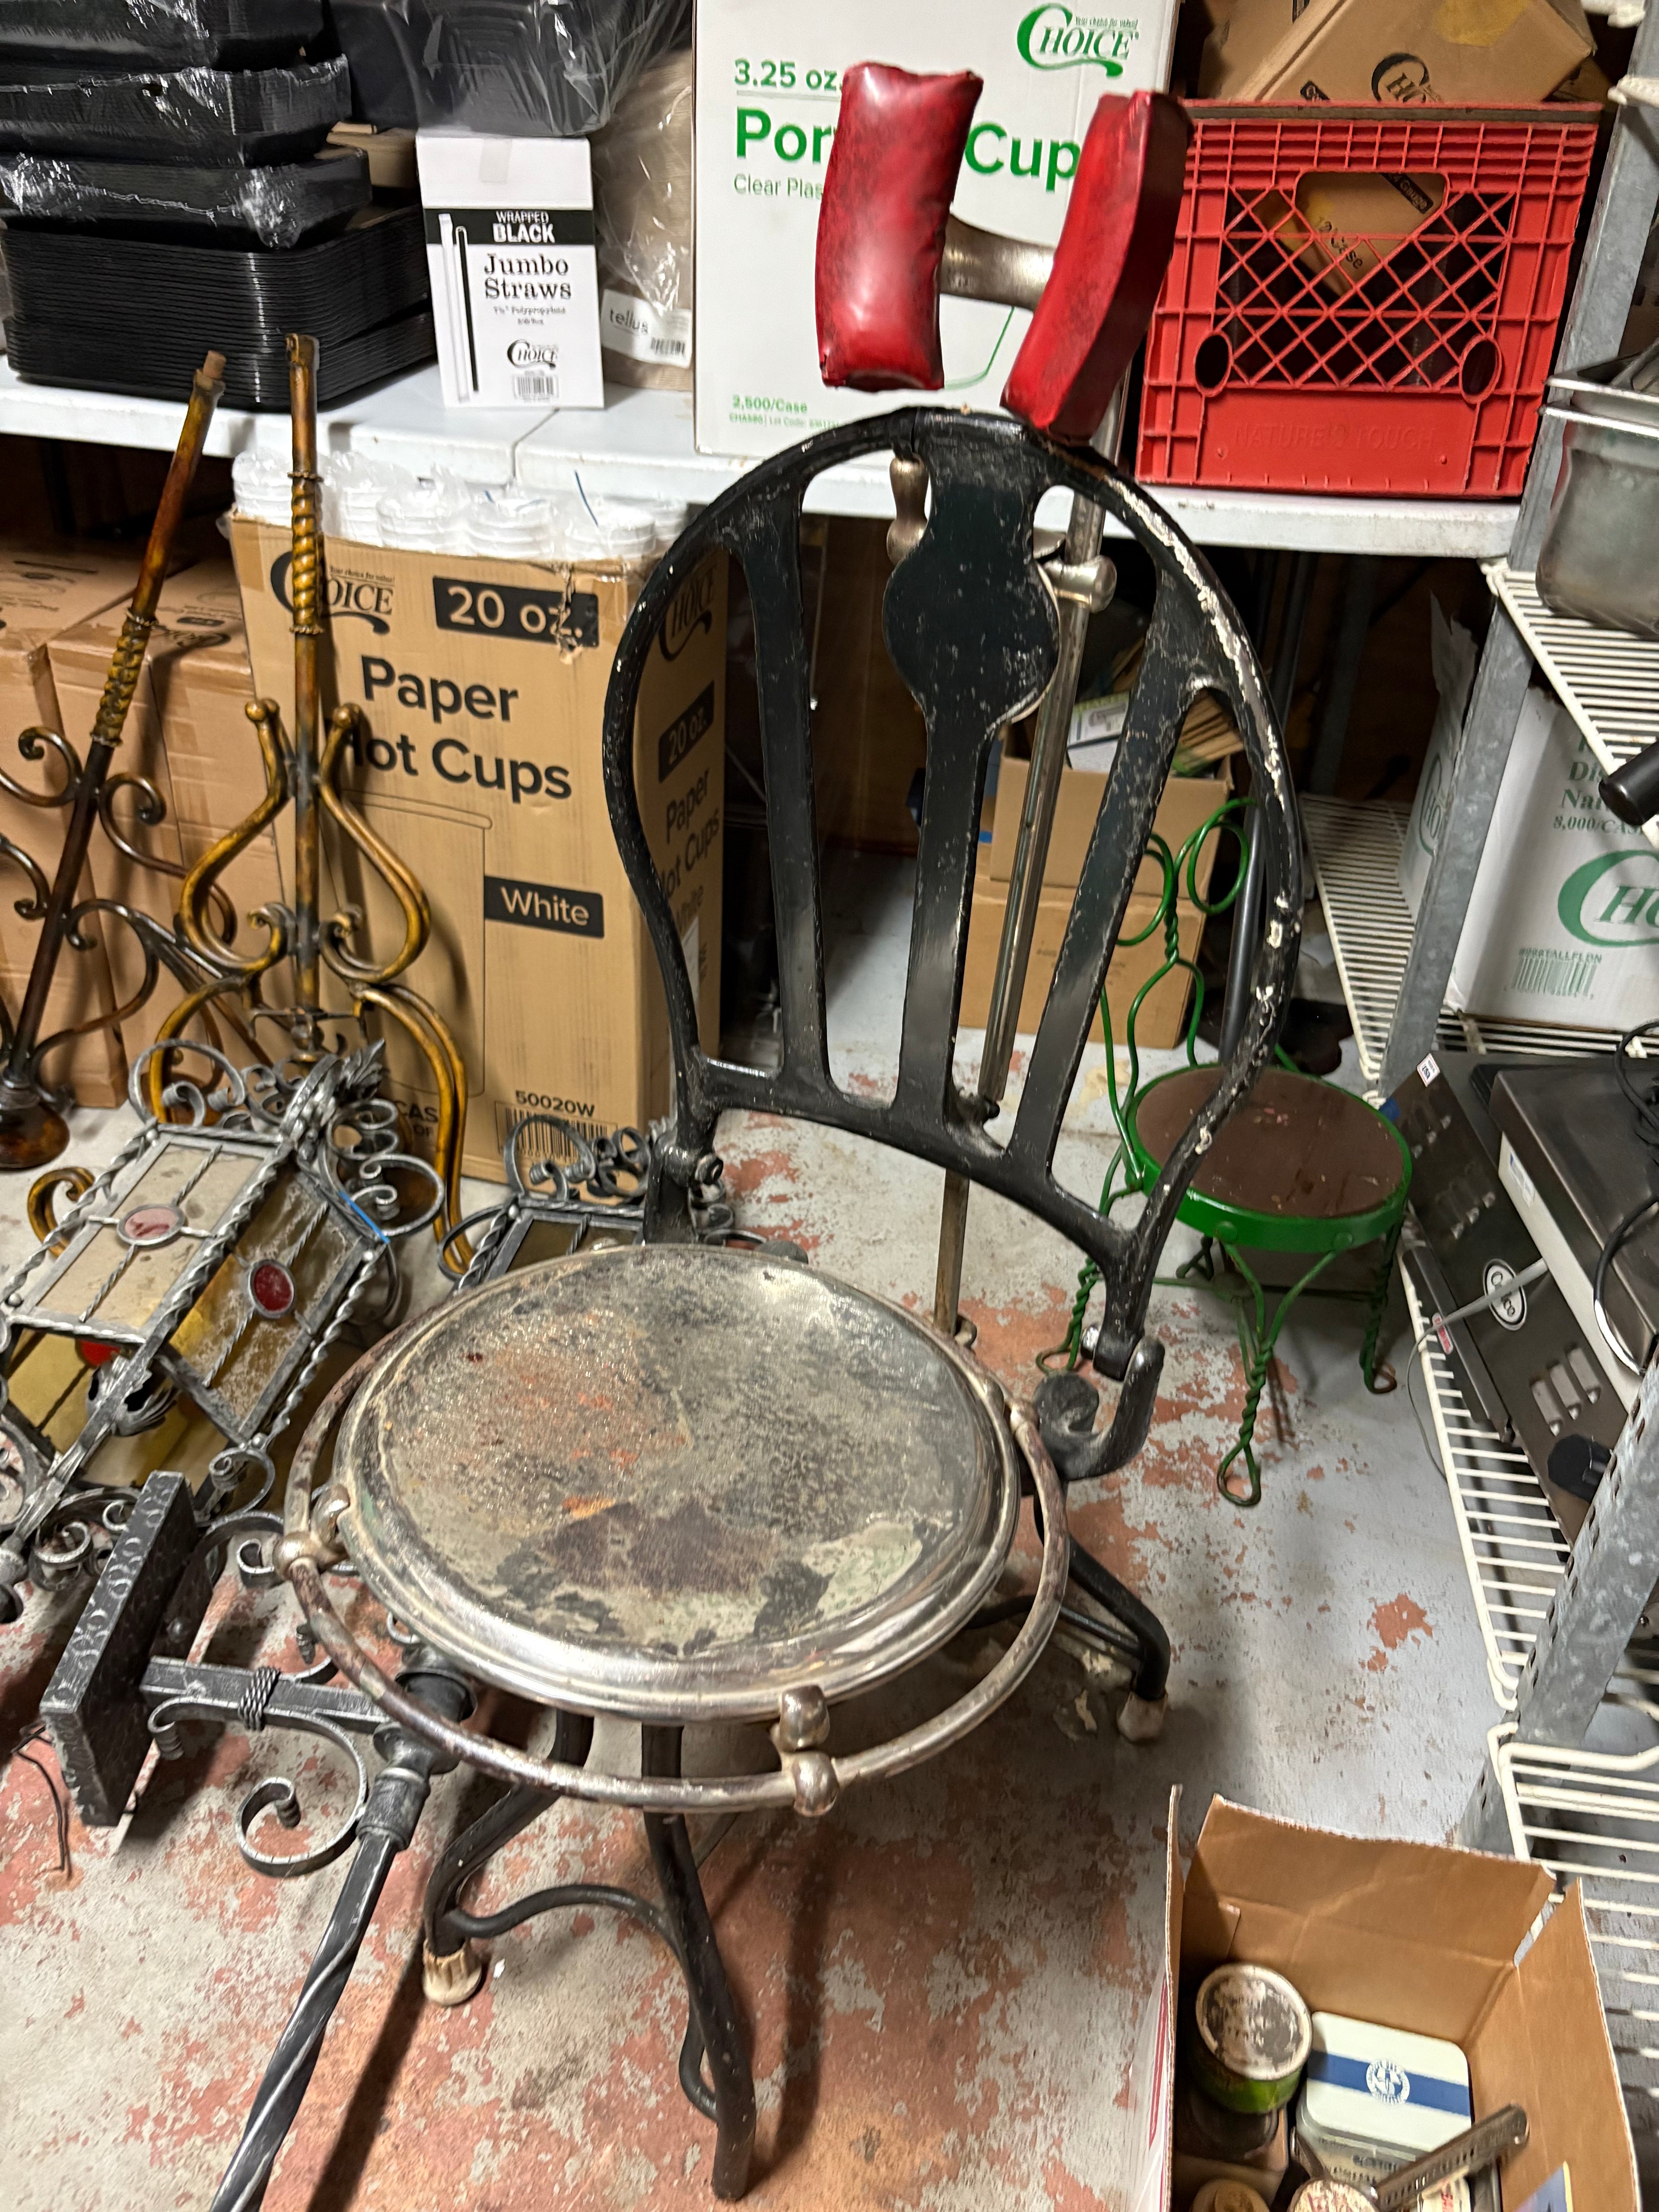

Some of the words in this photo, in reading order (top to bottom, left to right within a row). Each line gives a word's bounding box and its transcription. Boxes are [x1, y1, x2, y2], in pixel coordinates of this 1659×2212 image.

[1017, 3, 1138, 78] CHOICE
[734, 57, 796, 89] 3.25
[805, 69, 842, 92] oz.
[737, 106, 837, 164] Por
[734, 174, 781, 196] Clear
[493, 222, 556, 243] BLACK
[496, 210, 550, 224] WRAPPED
[484, 252, 569, 276] Jumbo
[485, 277, 572, 299] Straws
[610, 309, 648, 335] tellus
[270, 551, 394, 634] COICE
[448, 585, 505, 629] 20
[520, 604, 583, 639] oz.
[361, 655, 518, 724] Paper
[668, 718, 687, 765] 20
[432, 737, 572, 804] Cups
[667, 769, 709, 844] Paper
[685, 808, 719, 871] Cups
[500, 886, 589, 926] White
[515, 1090, 595, 1117] 50020W
